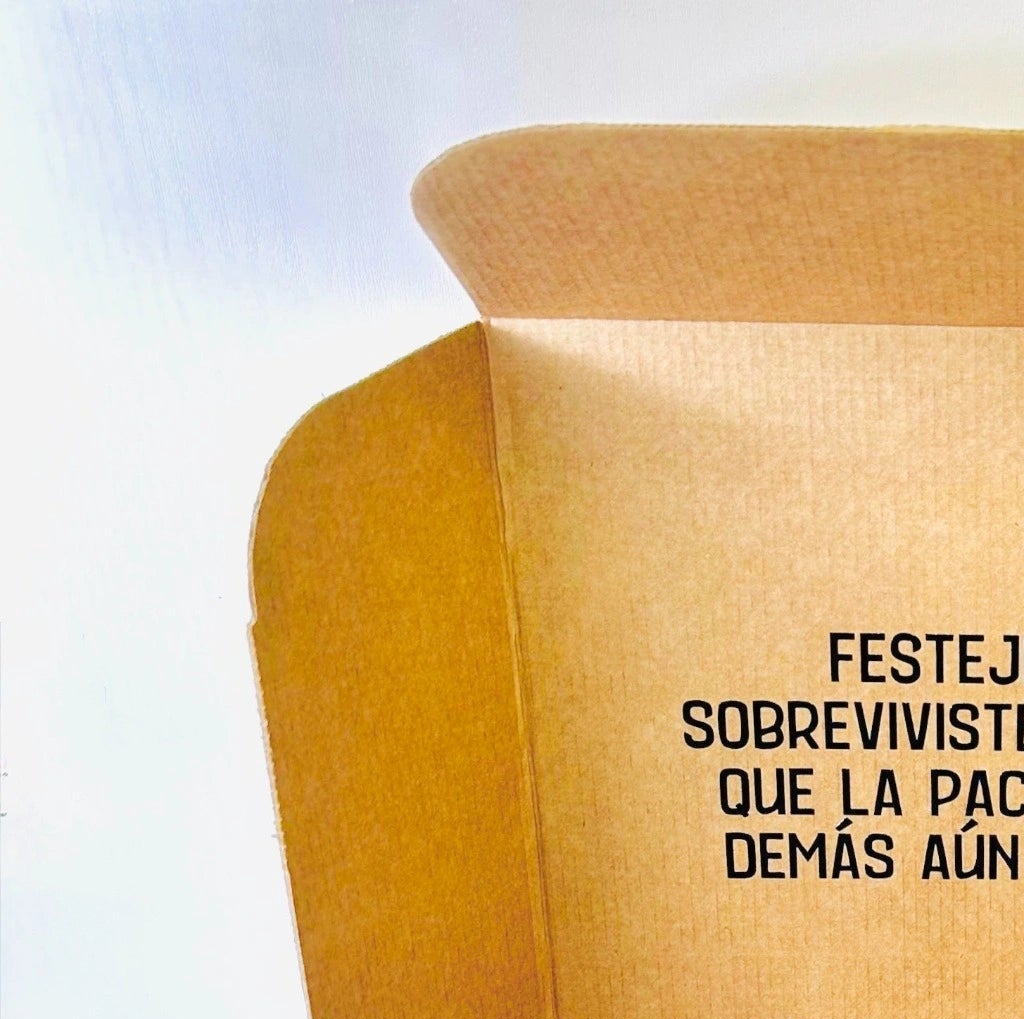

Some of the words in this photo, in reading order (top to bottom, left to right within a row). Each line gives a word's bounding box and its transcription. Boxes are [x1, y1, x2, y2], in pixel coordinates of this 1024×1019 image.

[719, 767, 813, 817] QUE
[842, 769, 901, 817] LA
[725, 817, 893, 879] DEMÁS
[922, 818, 1019, 880] AÚN
